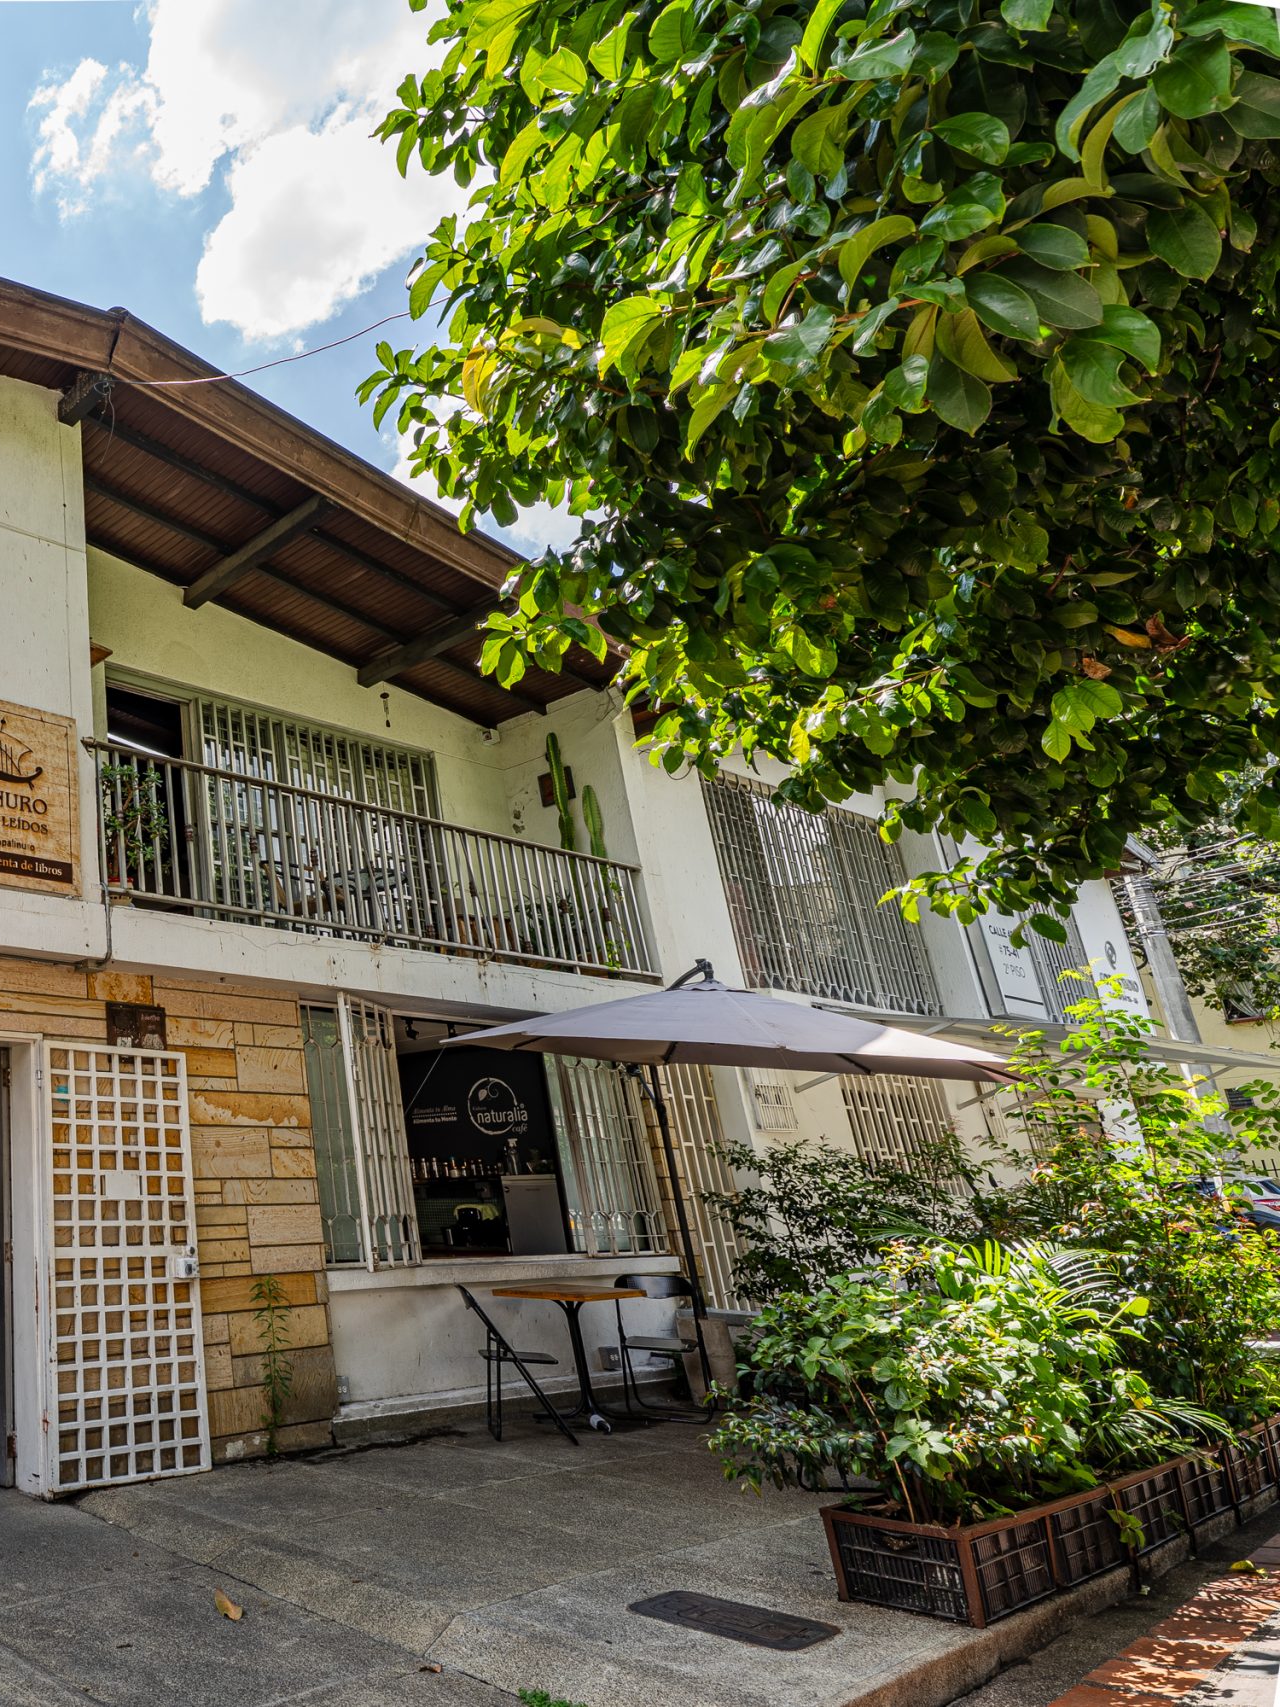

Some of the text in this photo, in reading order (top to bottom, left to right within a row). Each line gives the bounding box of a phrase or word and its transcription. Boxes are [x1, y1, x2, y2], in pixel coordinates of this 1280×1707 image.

[1, 815, 48, 835] LEÍDOS
[20, 860, 33, 871] de
[35, 862, 63, 876] libros
[477, 1106, 528, 1124] naturalia
[512, 1123, 528, 1133] café
